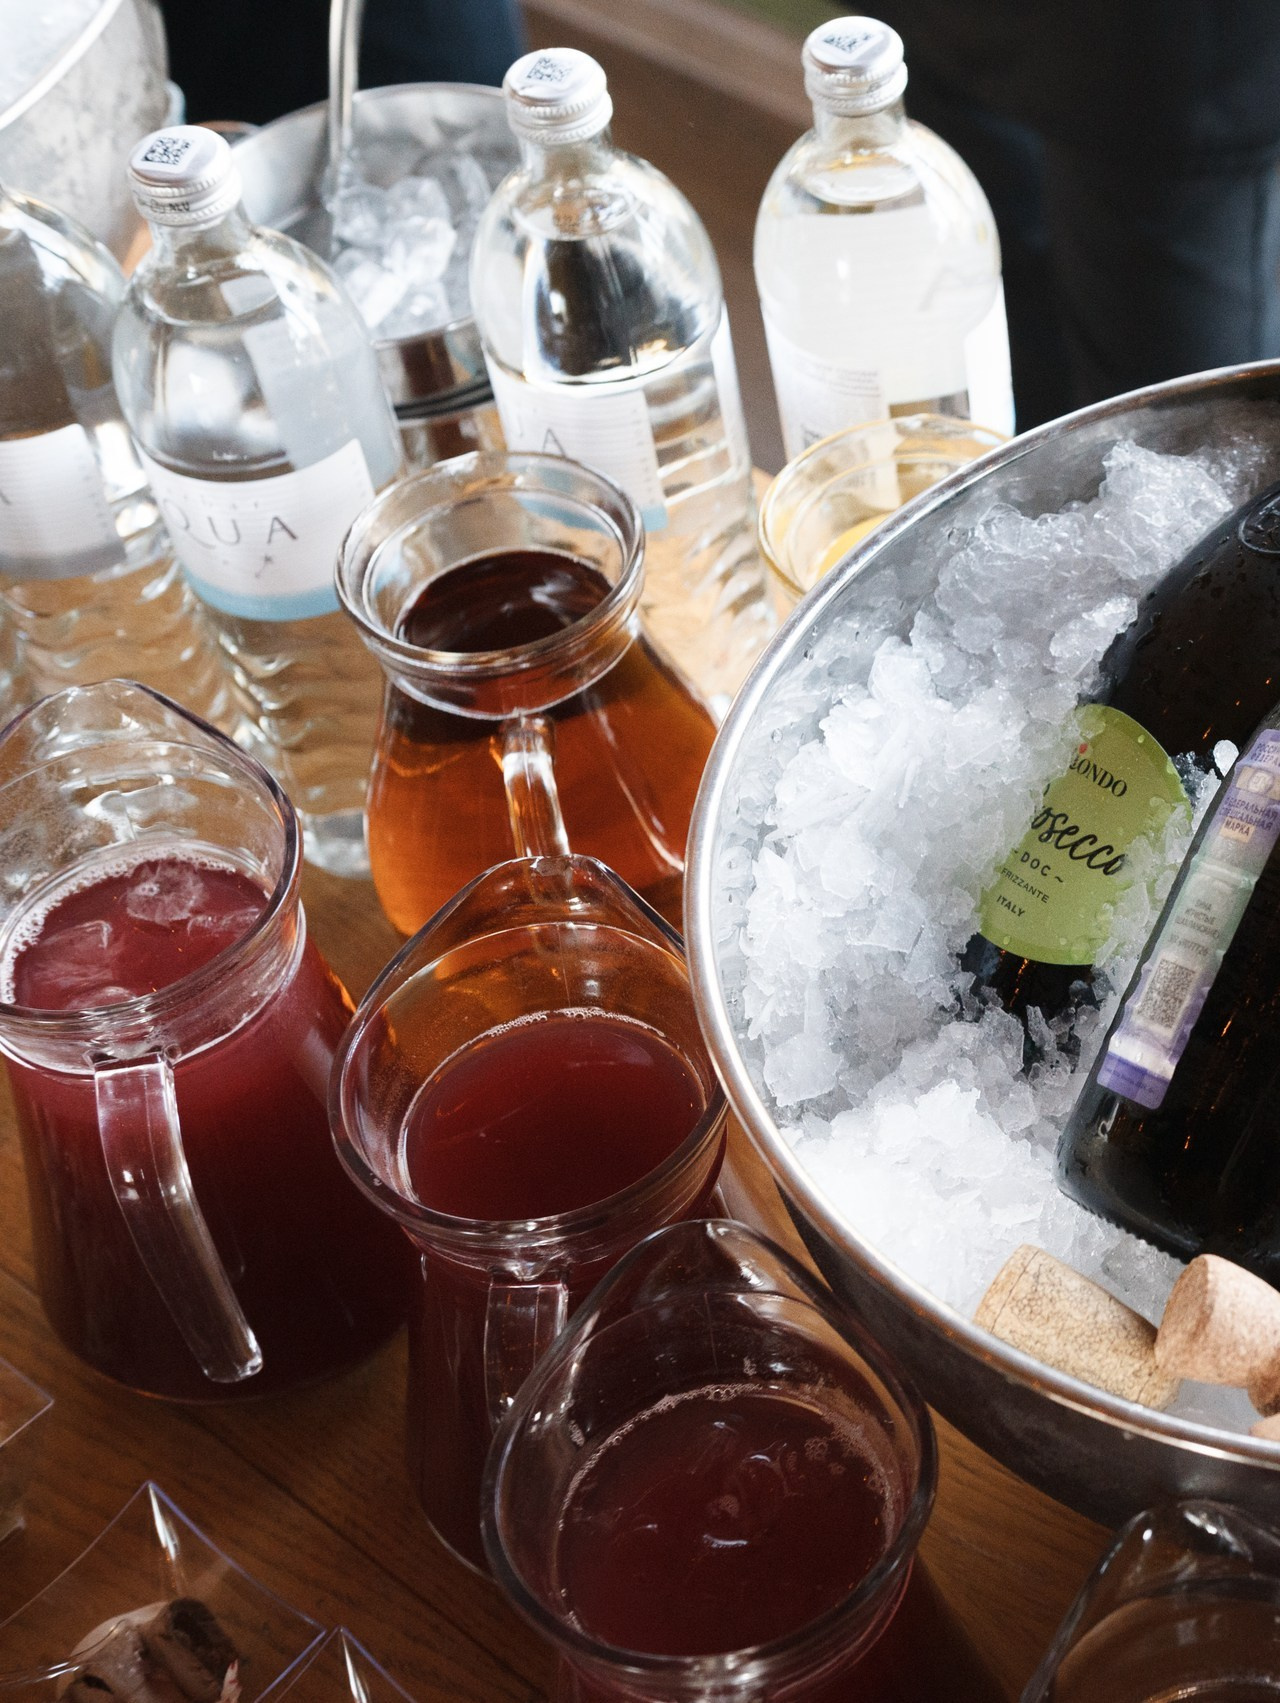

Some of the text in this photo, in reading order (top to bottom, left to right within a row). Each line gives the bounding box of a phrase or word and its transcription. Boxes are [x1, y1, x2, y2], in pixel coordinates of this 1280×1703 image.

[1031, 805, 1130, 876] osecco
[1224, 818, 1251, 838] МАРКА
[1020, 852, 1051, 877] DOC
[1000, 867, 1050, 904] FRIZZANTE
[996, 894, 1026, 918] ITALY
